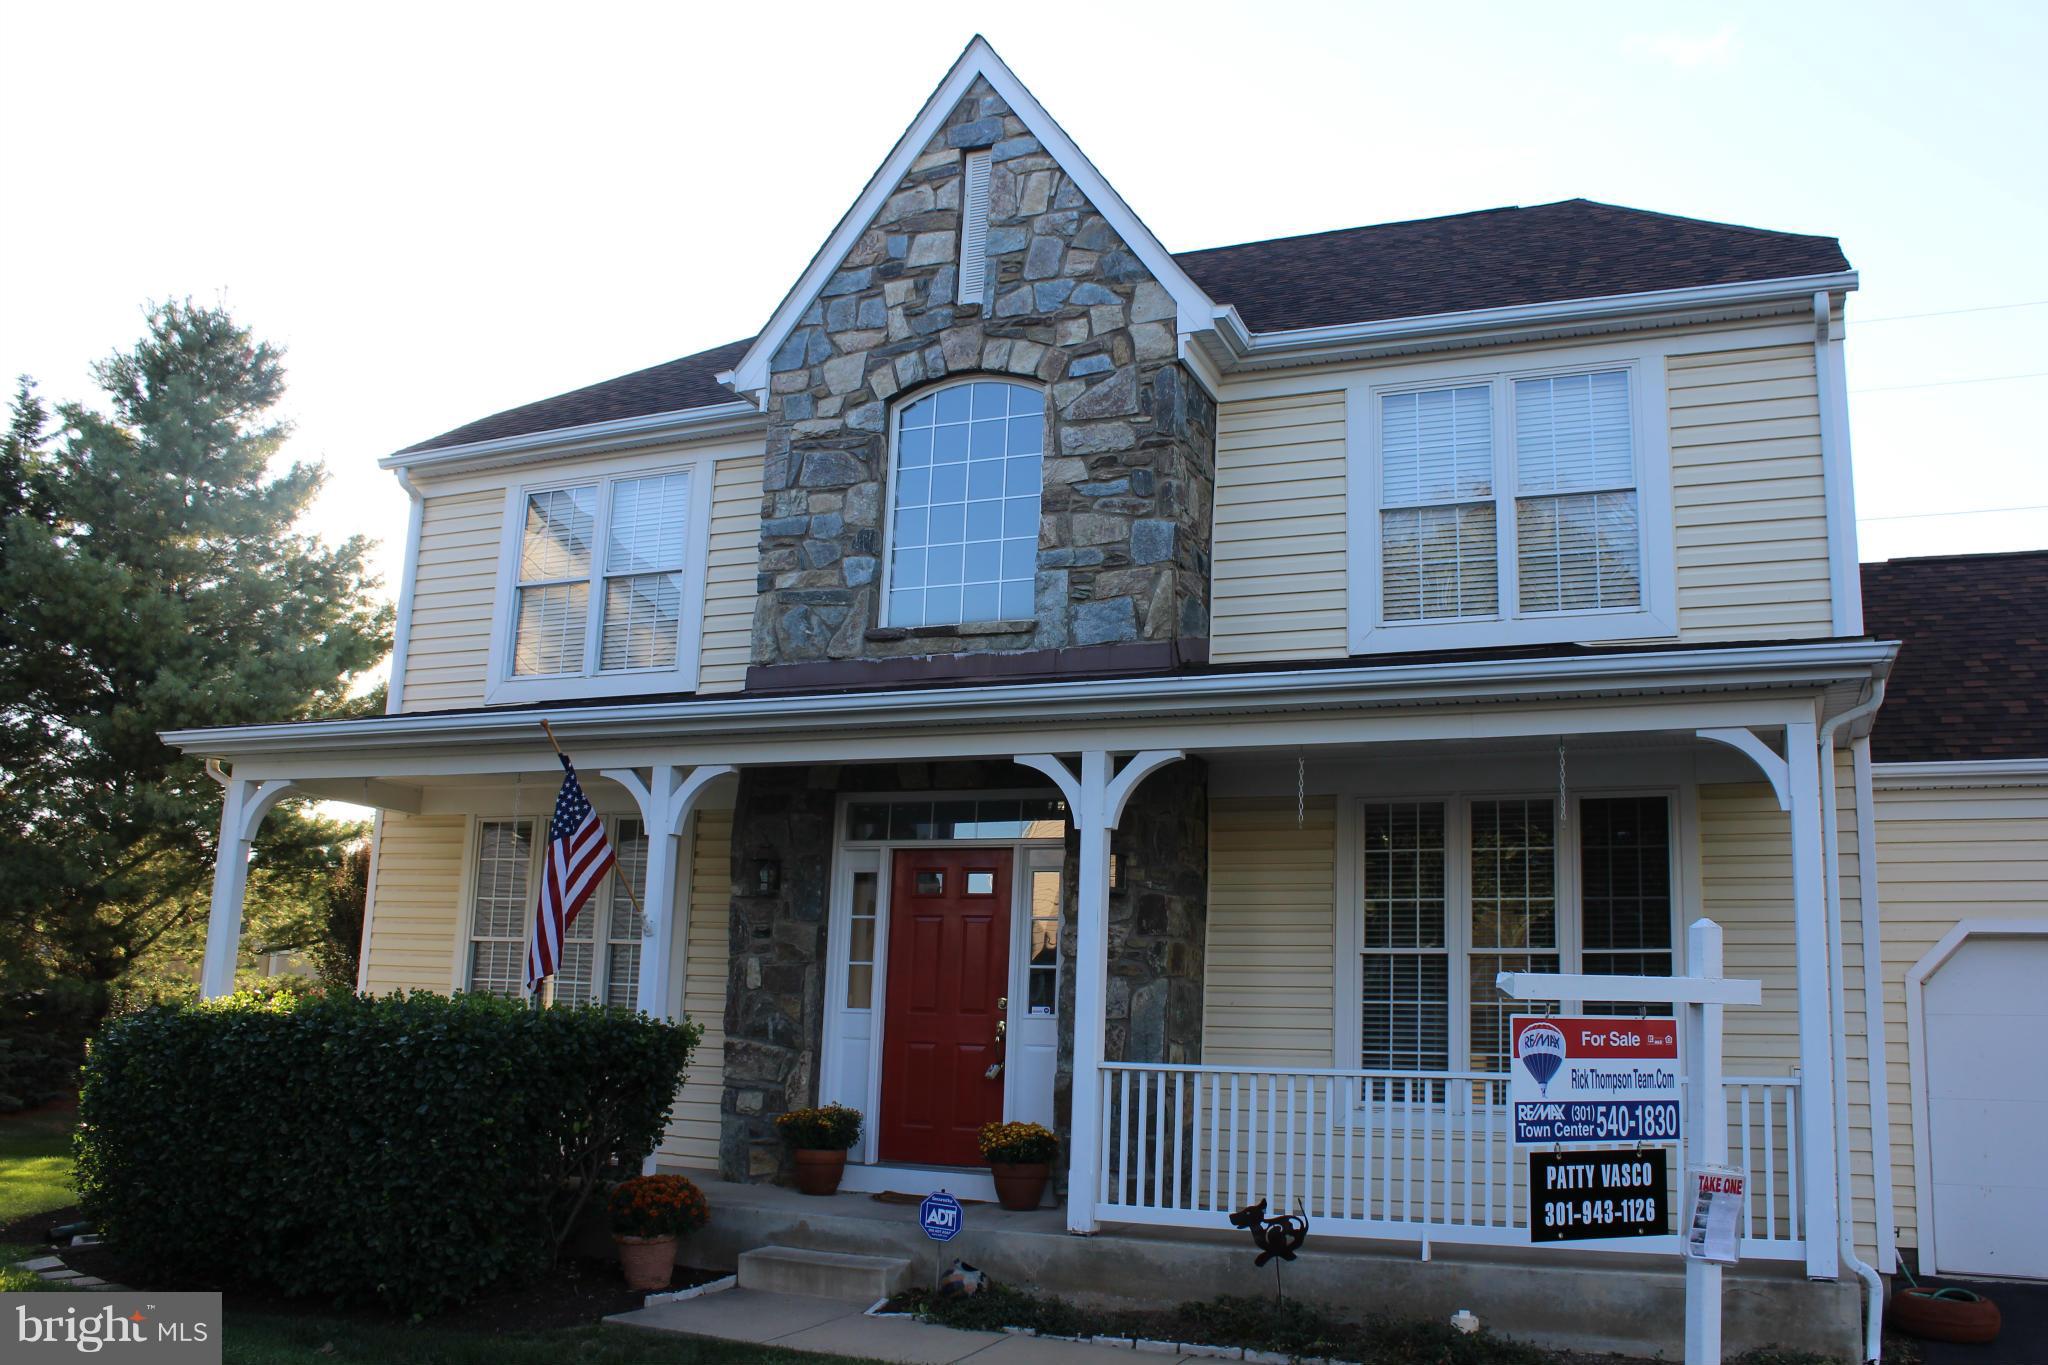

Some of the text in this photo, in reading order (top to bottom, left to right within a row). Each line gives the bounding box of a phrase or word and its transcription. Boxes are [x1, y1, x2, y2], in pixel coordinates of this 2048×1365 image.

[1524, 1032, 1560, 1050] RE/MAX
[1581, 1031, 1607, 1047] For
[1609, 1031, 1641, 1047] Sale
[1571, 1069, 1590, 1089] Rick
[1590, 1069, 1633, 1094] Thompson
[1518, 1103, 1595, 1122] RE/MAX (301)
[1596, 1104, 1677, 1137] 540-1830
[1518, 1122, 1595, 1138] Town Center
[1546, 1162, 1652, 1190] PATTY VASCO
[1698, 1175, 1743, 1195] TAKE ONE
[927, 1208, 956, 1226] ADT
[1544, 1198, 1656, 1227] 301-943-1126
